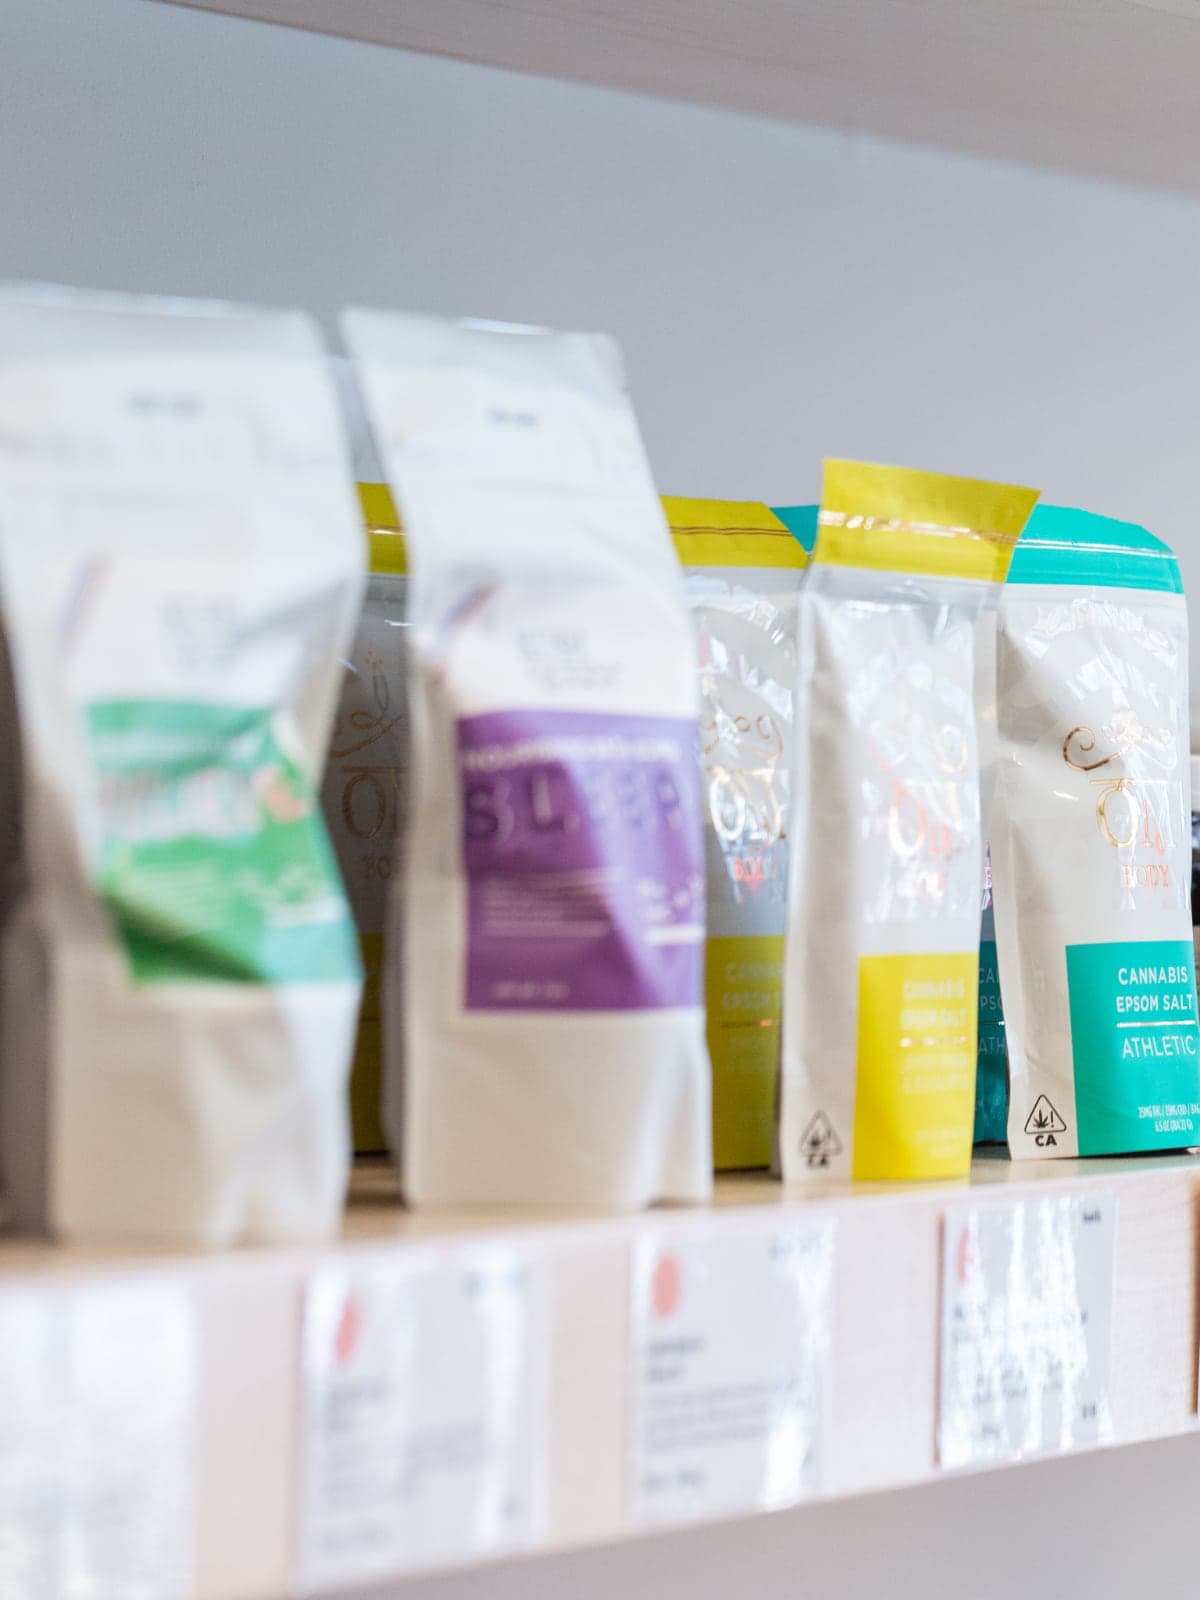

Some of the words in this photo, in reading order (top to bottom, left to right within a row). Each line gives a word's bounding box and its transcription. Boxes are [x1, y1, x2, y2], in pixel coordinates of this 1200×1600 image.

[1117, 967, 1189, 986] CANNABIS
[1116, 995, 1159, 1013] EPSOM
[1163, 994, 1194, 1011] SALT
[1122, 1035, 1197, 1059] ATHLETIC
[1035, 1135, 1058, 1147] CA
